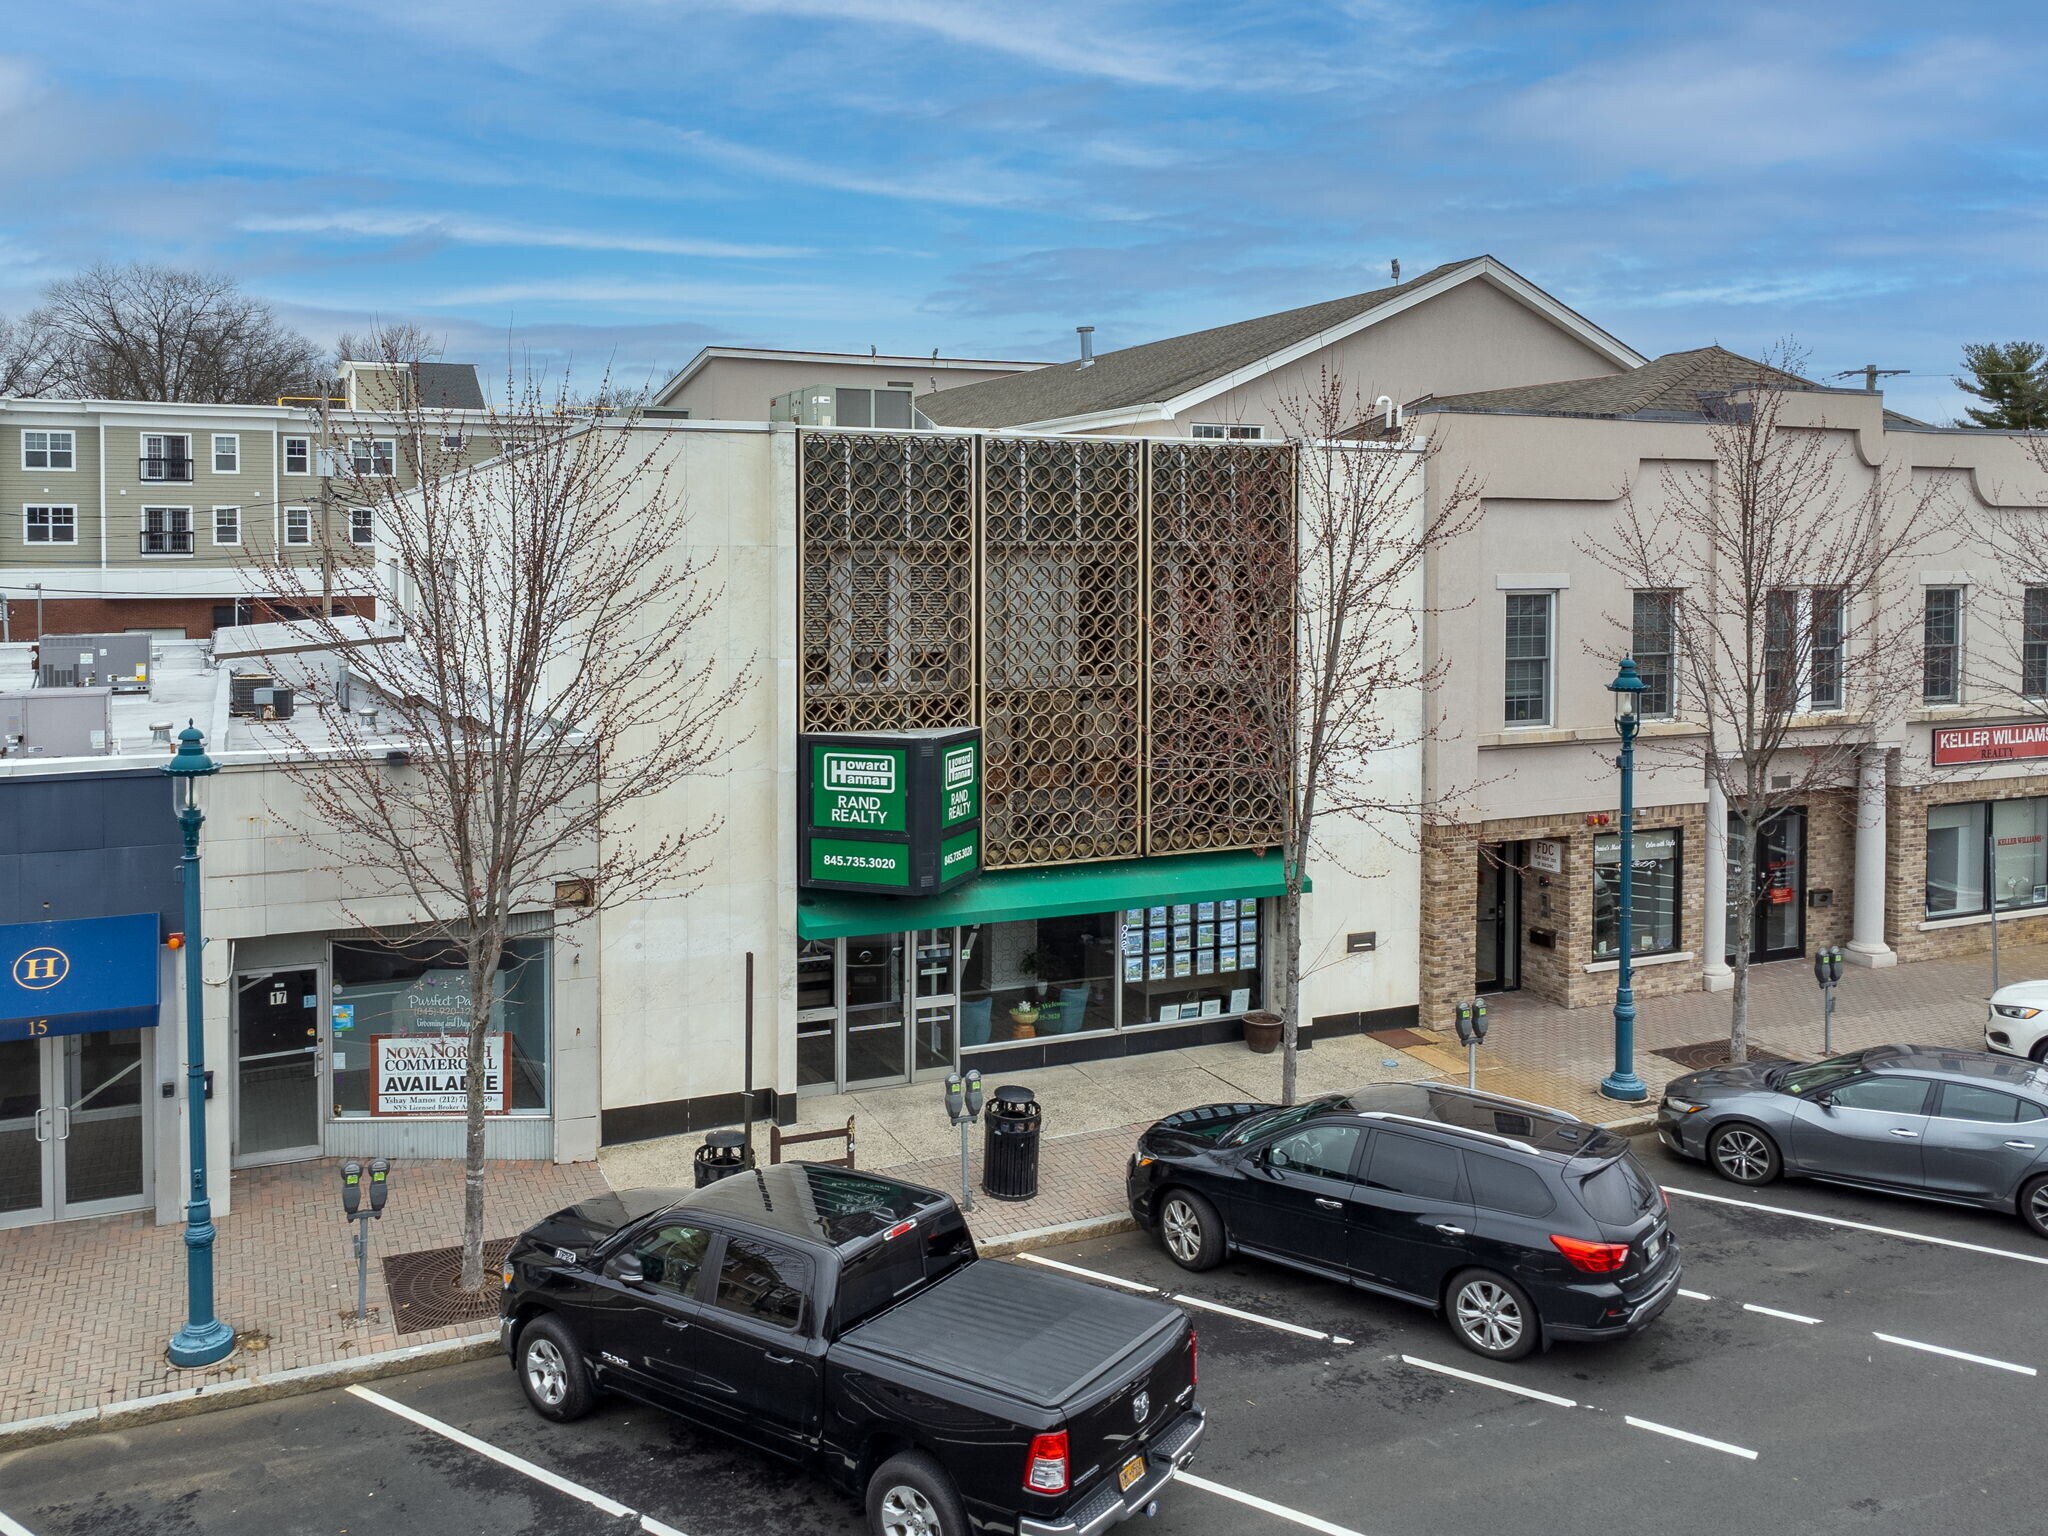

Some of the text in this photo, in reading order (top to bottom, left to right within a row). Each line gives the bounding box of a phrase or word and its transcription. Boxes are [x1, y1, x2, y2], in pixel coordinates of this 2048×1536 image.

[1940, 730, 1989, 749] KELLER
[1980, 747, 2014, 760] REALTY
[838, 795, 881, 810] RAND
[950, 789, 968, 807] RAND
[831, 809, 888, 824] REALTY
[949, 801, 971, 820] REALTY
[1536, 841, 1554, 856] FDC
[823, 854, 896, 870] 845.735.3020
[24, 957, 59, 980] H
[272, 991, 286, 1005] 17
[407, 994, 455, 1008] Purrfect
[28, 1019, 48, 1036] 15
[385, 1058, 498, 1071] COMMERCL
[385, 1076, 498, 1092] AVAILAE
